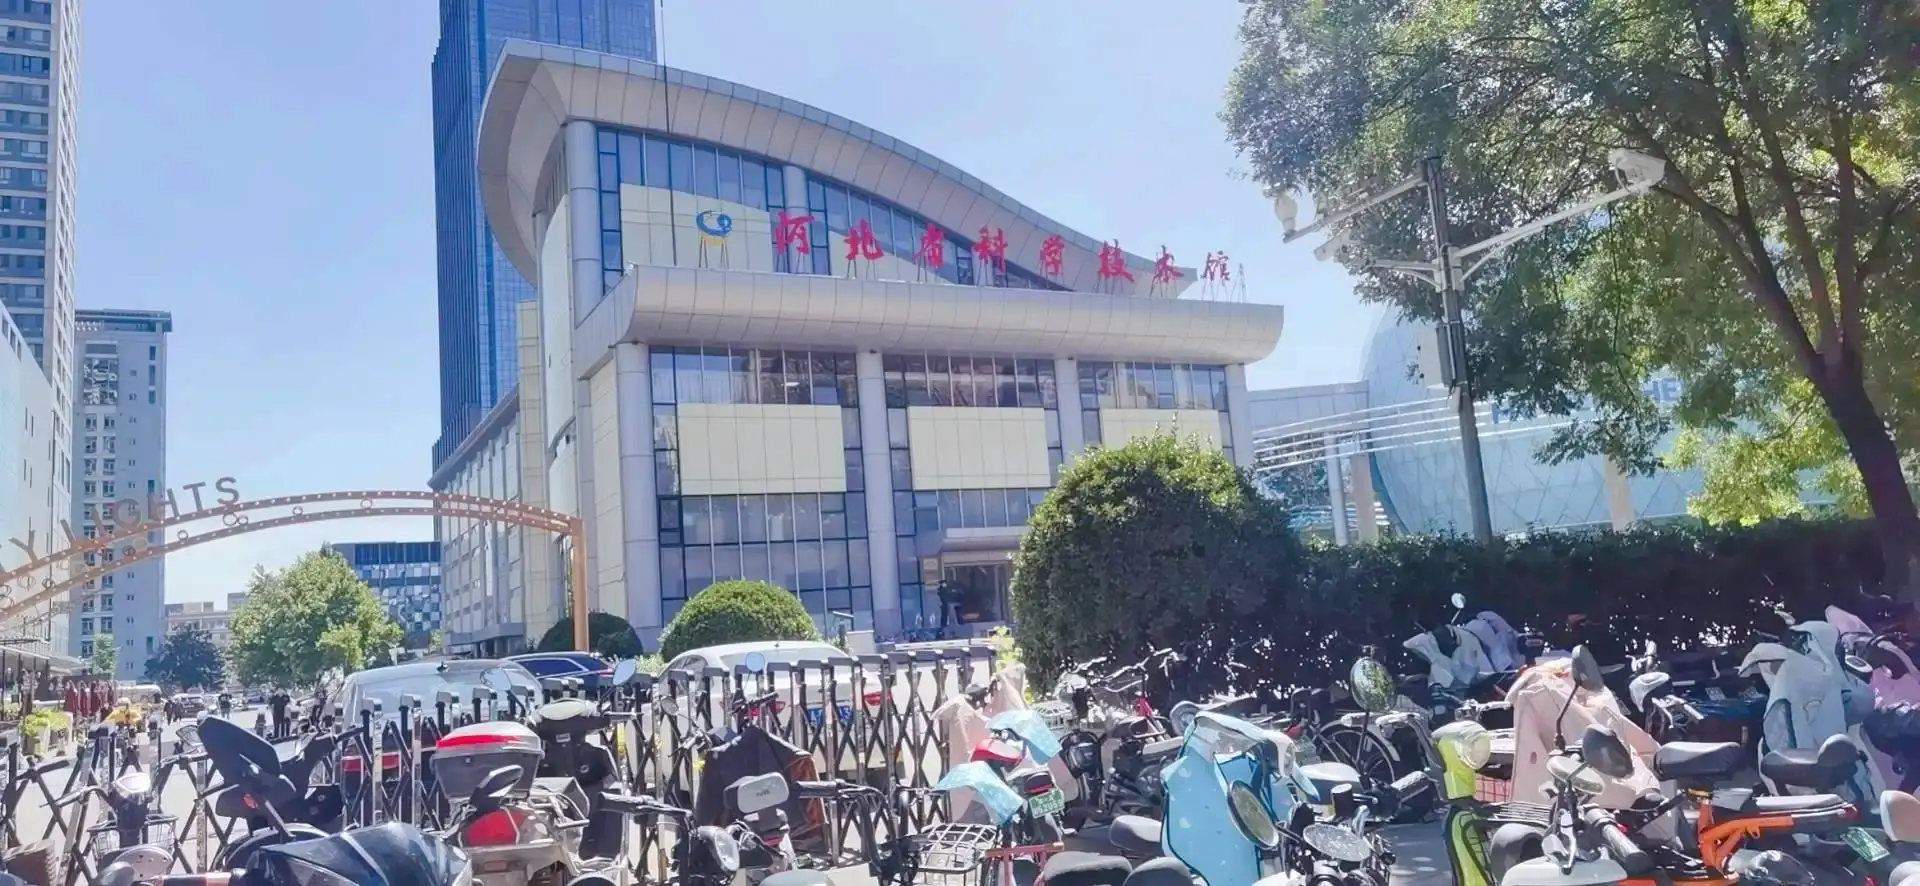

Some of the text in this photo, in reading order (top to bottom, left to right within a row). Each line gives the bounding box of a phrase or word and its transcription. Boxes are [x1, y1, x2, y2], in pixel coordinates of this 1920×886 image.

[774, 210, 1231, 283] 河北省科学技术馆
[60, 476, 240, 548] LIGHTS
